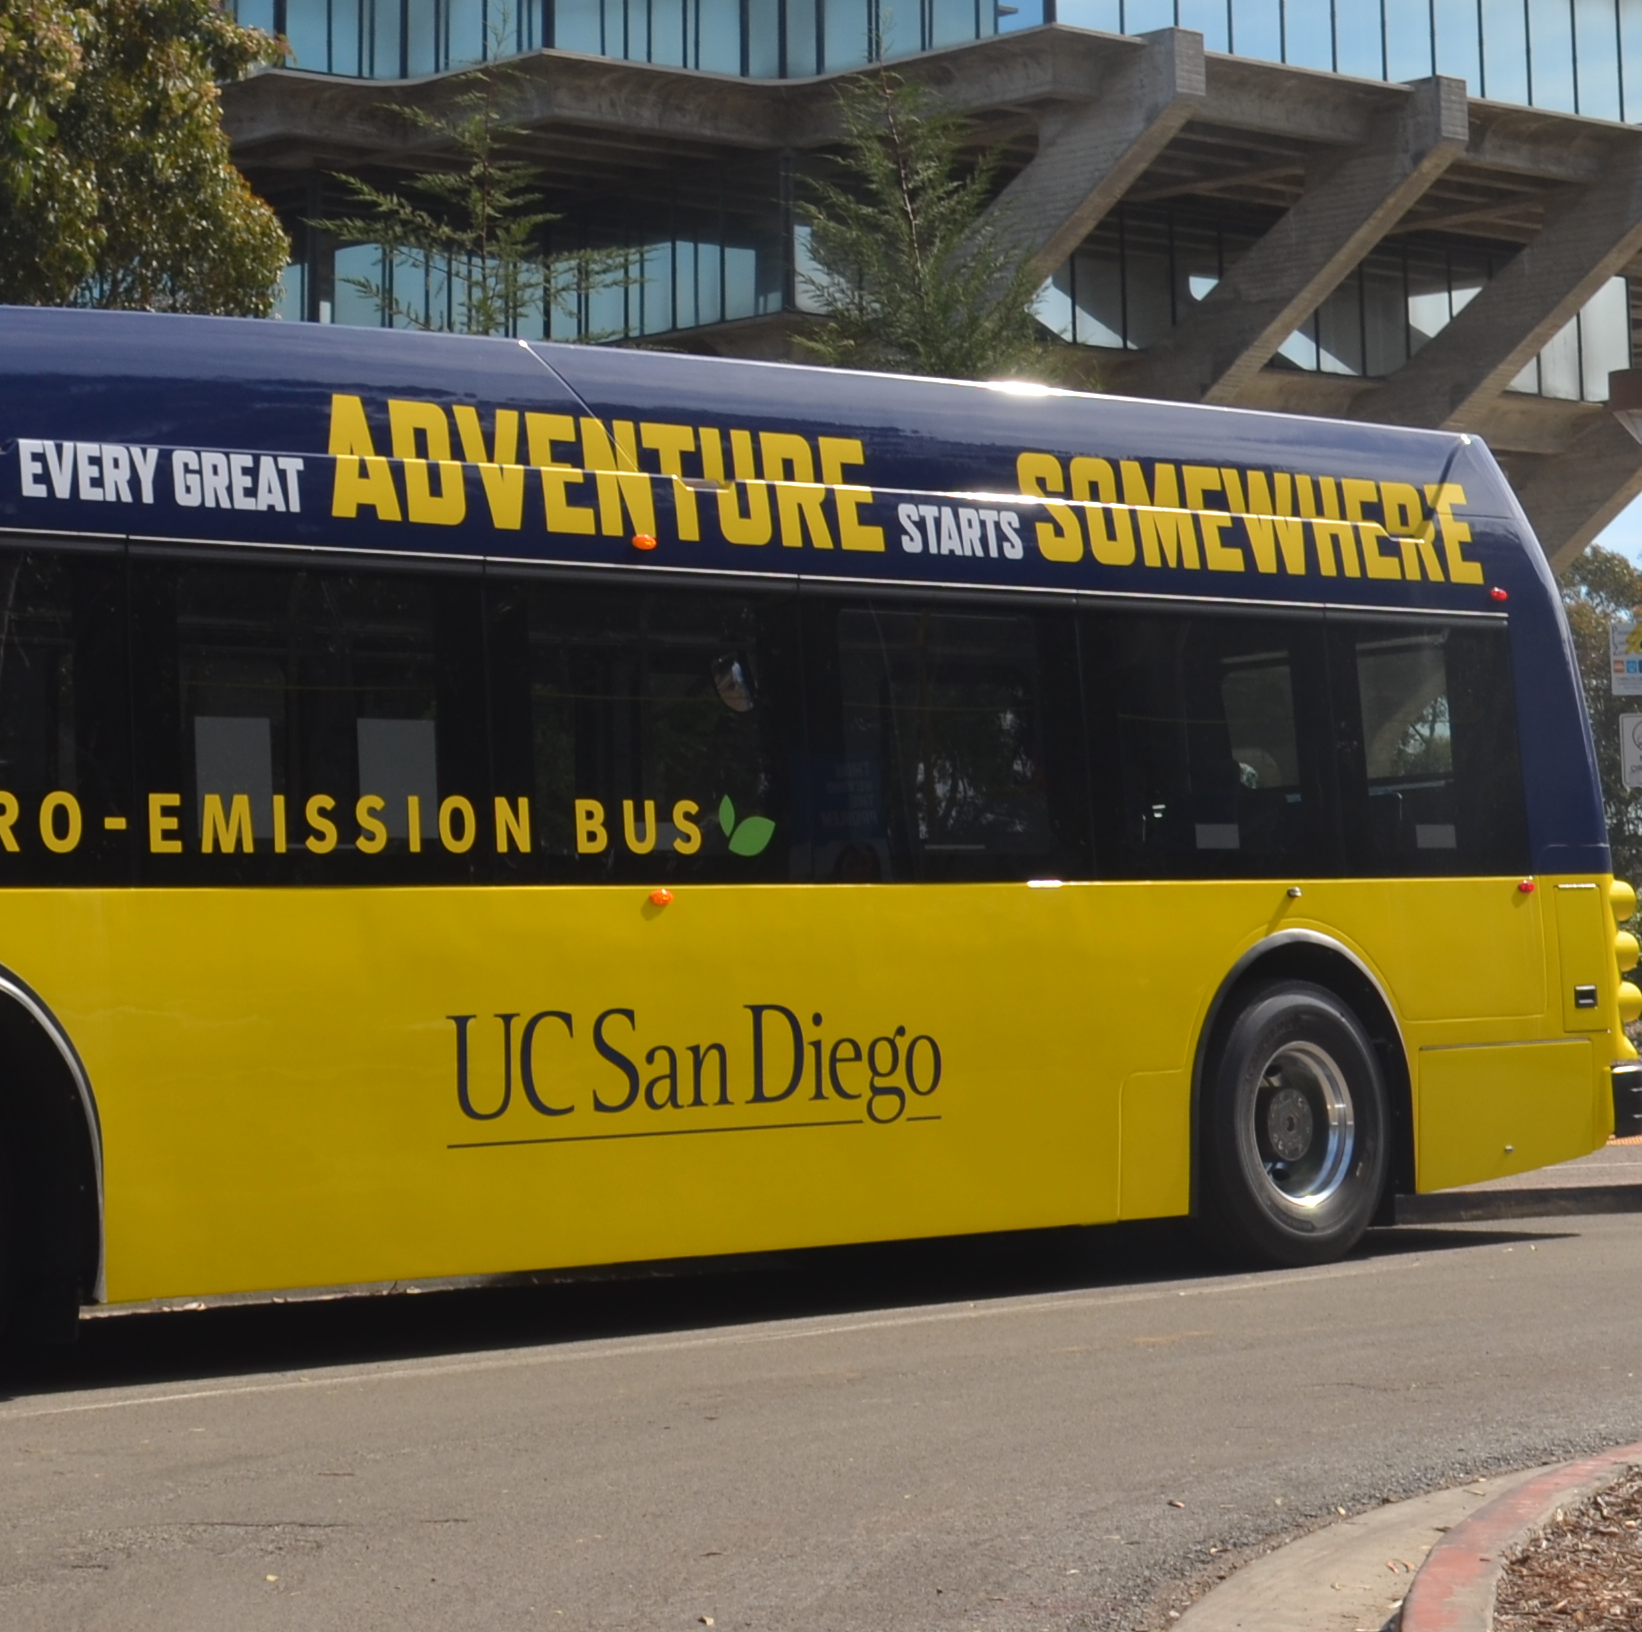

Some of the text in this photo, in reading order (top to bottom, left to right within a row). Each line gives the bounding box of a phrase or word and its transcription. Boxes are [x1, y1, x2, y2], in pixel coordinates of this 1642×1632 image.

[17, 393, 1485, 585] EVERY GREAT ADVENTURE STARTS SOMEWHERE
[573, 798, 703, 856] BUS
[445, 1002, 942, 1125] UC San Diego
